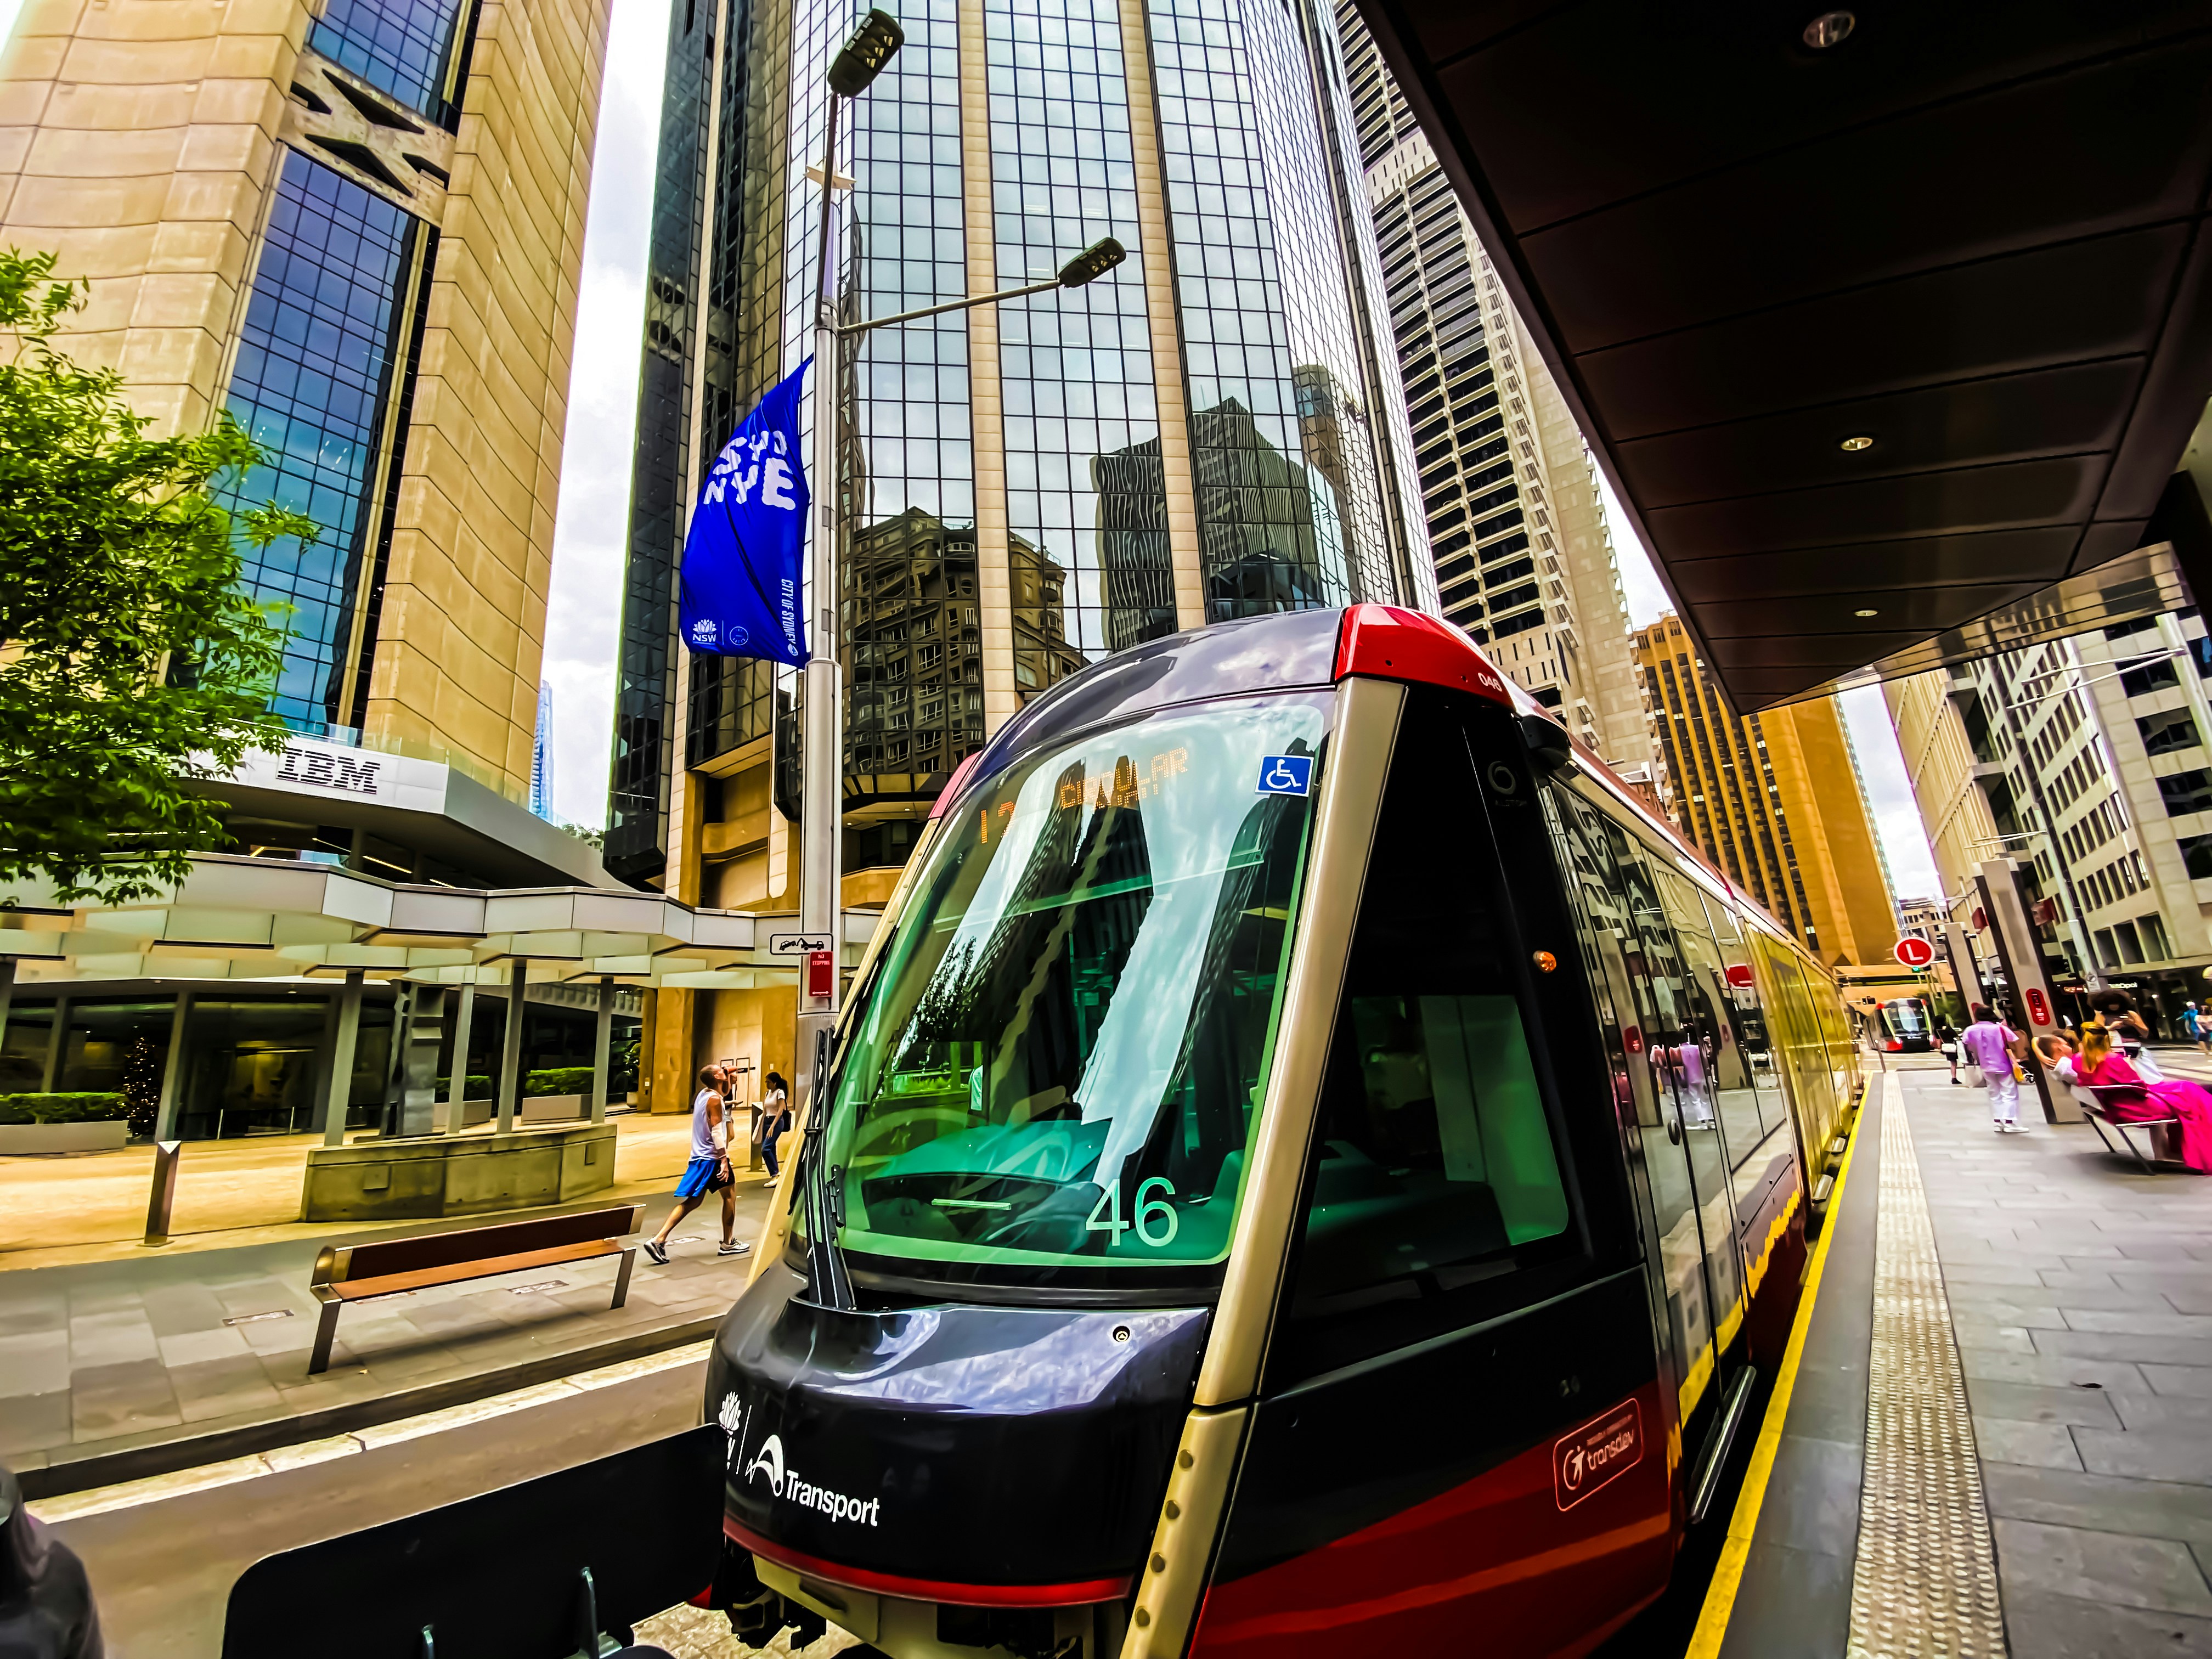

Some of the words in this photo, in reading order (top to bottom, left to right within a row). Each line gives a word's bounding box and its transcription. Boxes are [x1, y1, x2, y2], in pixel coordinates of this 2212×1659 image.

[703, 458, 795, 510] NYE
[781, 578, 793, 600] CITY
[781, 599, 794, 611] OF
[692, 634, 716, 642] NSW
[781, 610, 796, 645] SYDNEY
[1478, 673, 1503, 692] 048
[277, 747, 380, 793] IBM
[1905, 944, 1924, 961] L
[1086, 1177, 1178, 1247] 46
[1587, 1429, 1634, 1470] transdev
[786, 1470, 880, 1527] Transport
